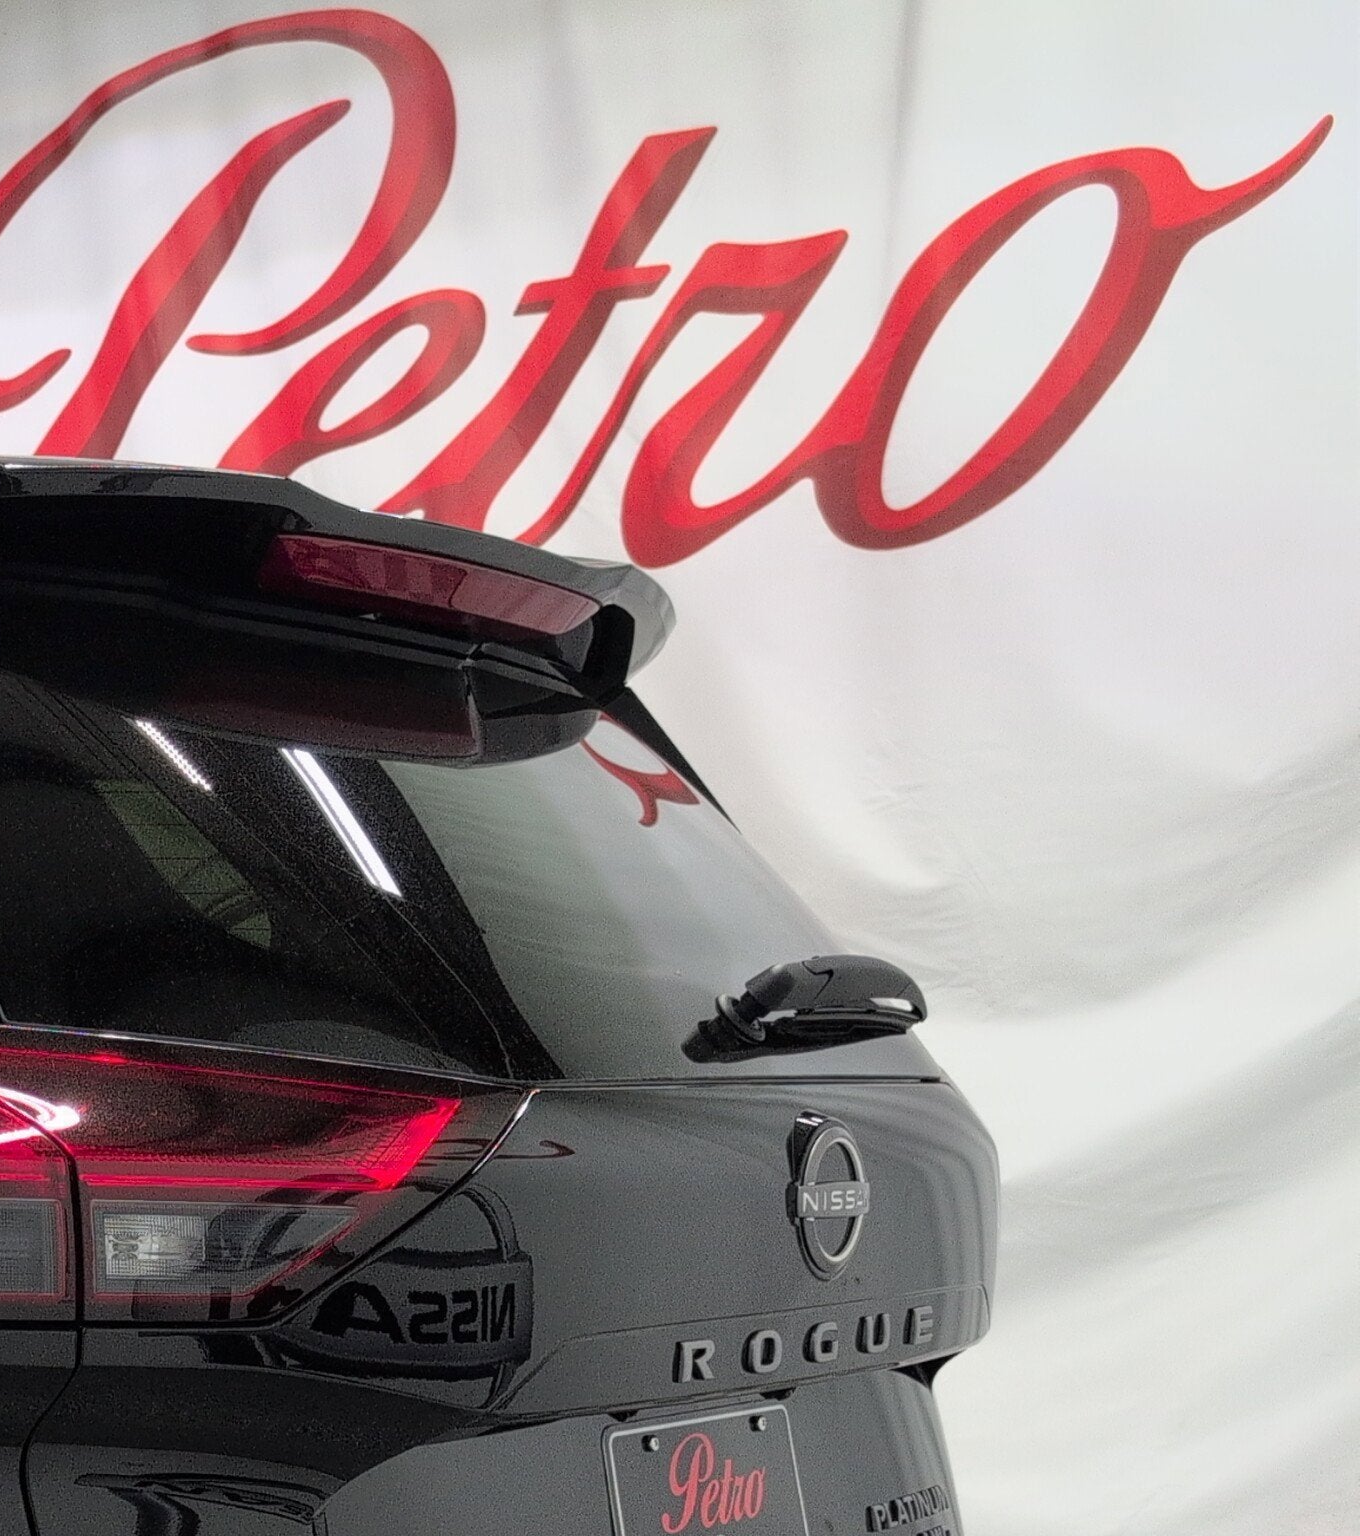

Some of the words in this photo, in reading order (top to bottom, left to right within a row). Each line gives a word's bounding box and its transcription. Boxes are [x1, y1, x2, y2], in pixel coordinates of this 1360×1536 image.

[672, 1305, 934, 1384] ROGUE
[661, 1432, 766, 1534] Petro
[866, 1485, 949, 1533] PLATINUM
